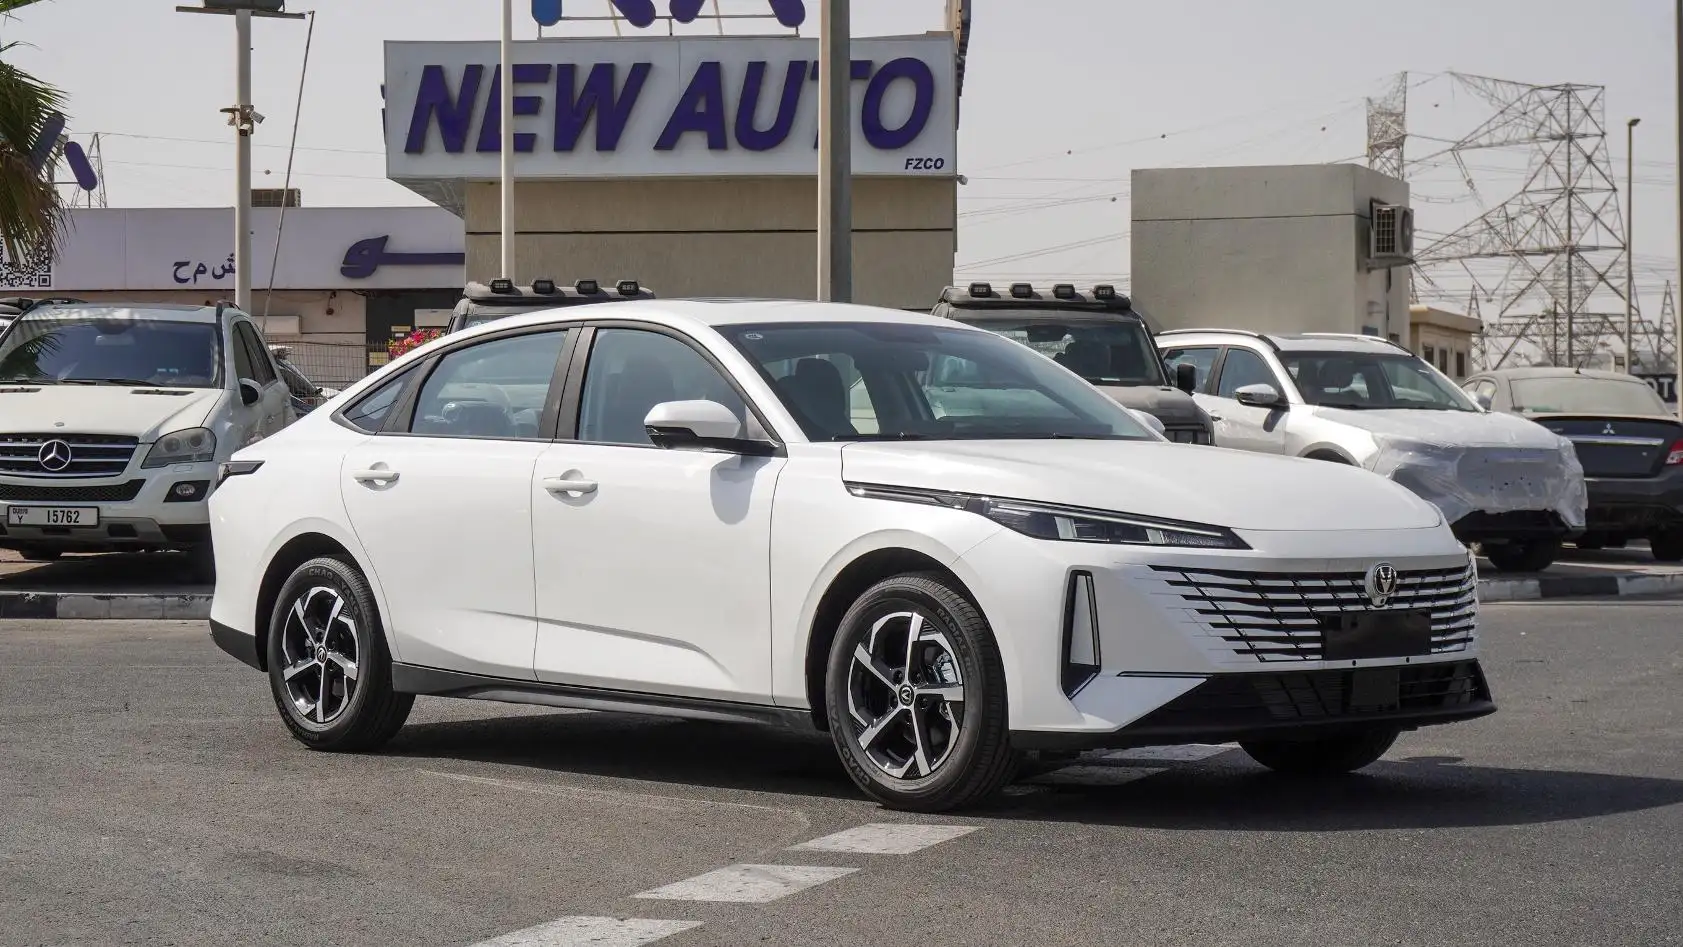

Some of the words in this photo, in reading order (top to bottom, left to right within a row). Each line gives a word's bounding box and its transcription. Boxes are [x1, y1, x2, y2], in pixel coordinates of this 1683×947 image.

[404, 63, 652, 152] NEW
[904, 157, 945, 170] FZCO
[47, 509, 80, 524] 15762
